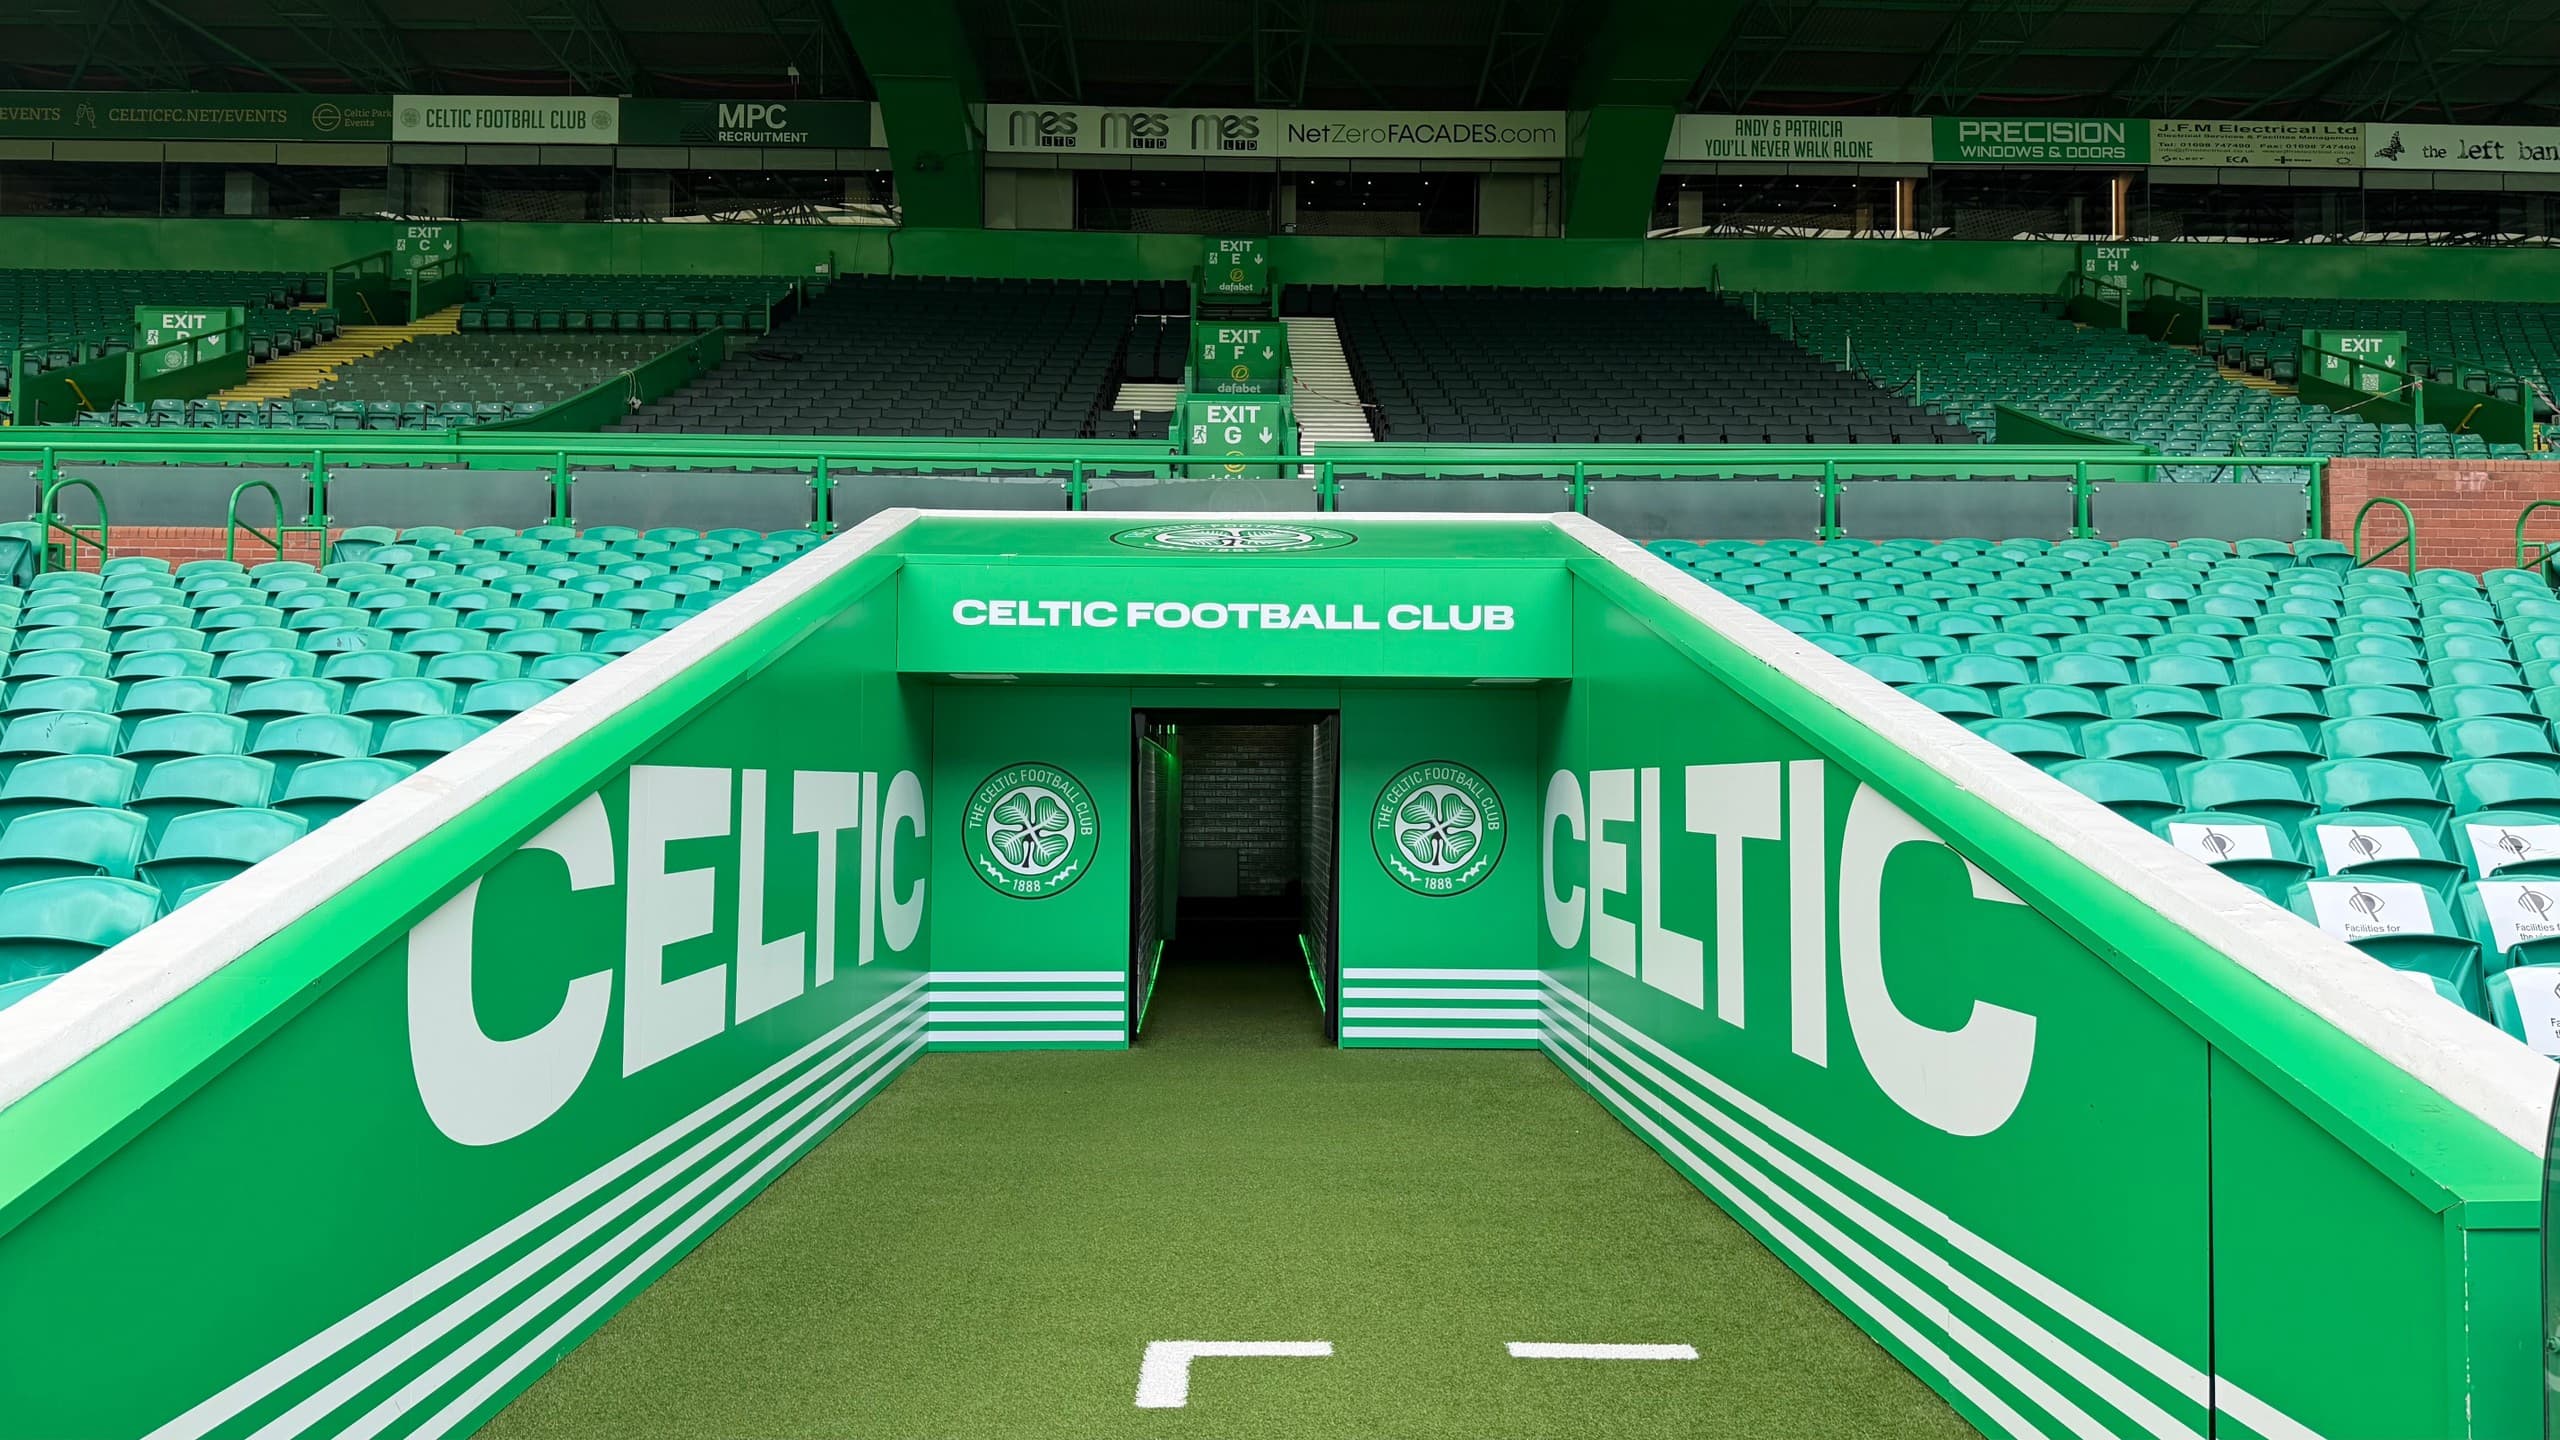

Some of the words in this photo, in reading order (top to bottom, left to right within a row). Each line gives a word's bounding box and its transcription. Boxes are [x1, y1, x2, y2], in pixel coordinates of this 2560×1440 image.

[0, 107, 61, 121] EVENTS
[109, 108, 287, 124] CELTICFC.NET/EVENTS
[344, 108, 370, 118] Celtic
[372, 109, 393, 119] Park
[426, 109, 471, 128] CELTIC
[476, 109, 545, 128] FOOTBALL
[551, 110, 586, 129] CLUB
[718, 103, 787, 129] MPC
[345, 118, 375, 128] Events
[1735, 119, 1768, 136] ANDY
[1773, 119, 1781, 137] &
[1786, 120, 1843, 138] PATRICIA
[2158, 123, 2211, 132] J.F.M
[2219, 124, 2316, 134] Electrical
[2324, 126, 2357, 134] Ltd
[718, 131, 808, 143] RECRUITMENT
[1288, 123, 1556, 143] NetZeroFACADES.com
[1959, 121, 2125, 143] PRECISION
[1042, 136, 1076, 147] LTD
[1133, 138, 1167, 149] LTD
[1223, 140, 1258, 151] LTD
[1705, 139, 1747, 157] YOU'LL
[1751, 140, 1790, 158] NEVER
[1794, 141, 1829, 159] WALK
[1833, 141, 1873, 159] ALONE
[1960, 145, 2044, 158] WINDOWS
[2048, 146, 2062, 159] &
[2066, 146, 2126, 159] DOORS
[2422, 145, 2447, 158] the
[2457, 139, 2504, 160] left
[2517, 141, 2560, 161] ban
[407, 226, 442, 238] EXIT
[419, 239, 431, 251] C
[1220, 240, 1253, 252] EXIT
[1231, 253, 1241, 265] E
[2097, 247, 2130, 259] EXIT
[2107, 260, 2119, 272] H
[1218, 282, 1253, 292] dafabet
[162, 314, 206, 329] EXIT
[1218, 329, 1261, 344] EXIT
[2341, 338, 2383, 353] EXIT
[1233, 346, 1245, 360] F
[1217, 383, 1261, 395] dafabet
[1207, 405, 1261, 424] EXIT
[1224, 426, 1242, 444] G
[953, 599, 1124, 627] CELTIC
[1127, 601, 1380, 629] FOOTBALL
[1387, 604, 1515, 631] CLUB
[969, 803, 986, 829] THE
[980, 772, 1018, 804] CELTIC
[1020, 769, 1080, 803] FOOTBALL
[1075, 801, 1093, 836] CLUB
[1377, 803, 1394, 830] THE
[1386, 771, 1423, 804] CELTIC
[1424, 767, 1485, 800] FOOTBALL
[1481, 797, 1500, 831] CLUB
[1013, 879, 1041, 893] 1888
[1425, 876, 1453, 890] 1888
[2345, 923, 2384, 932] Facilities
[2387, 923, 2401, 932] for
[2515, 923, 2555, 932] Facilities
[1543, 759, 2038, 1137] CELTIC
[407, 765, 926, 1147] CELTIC
